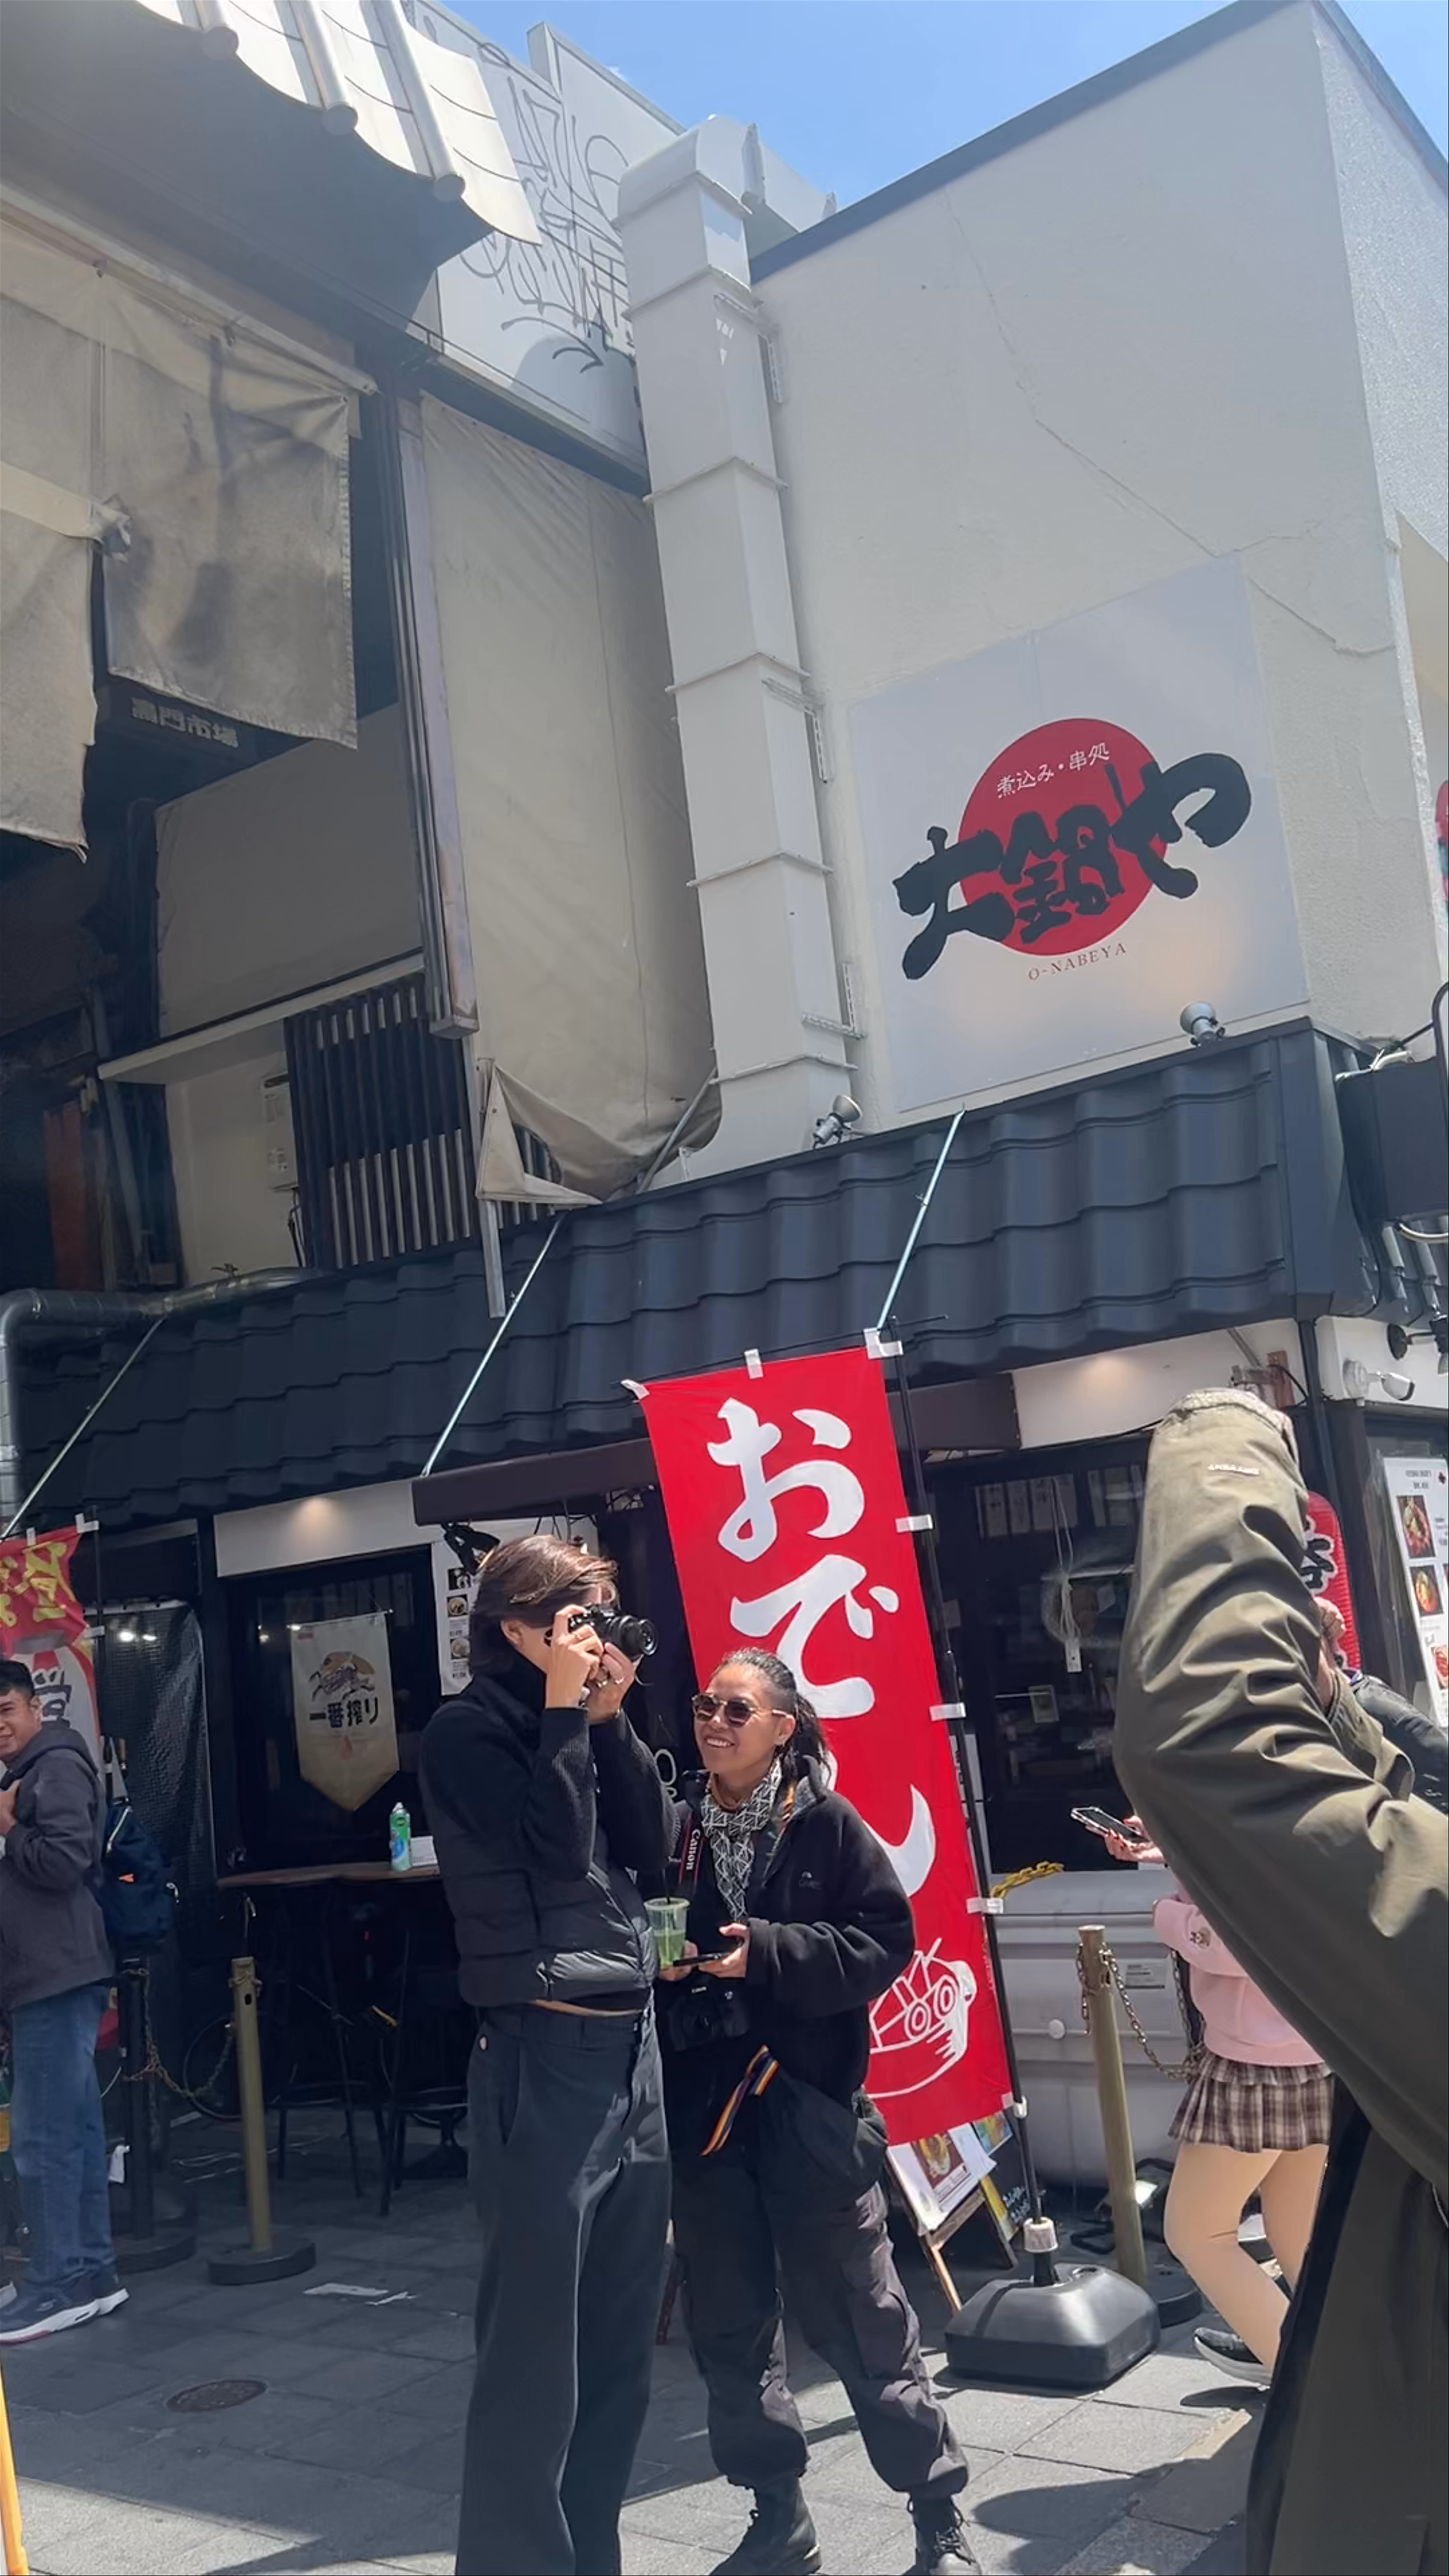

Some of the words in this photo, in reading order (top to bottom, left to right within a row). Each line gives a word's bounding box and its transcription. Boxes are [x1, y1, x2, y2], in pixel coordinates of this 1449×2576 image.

[997, 742, 1110, 798] 煮込み・串処
[1028, 943, 1126, 980] O-NABEYA
[309, 1697, 378, 1729] 一番搾り
[685, 1829, 701, 1871] Canon
